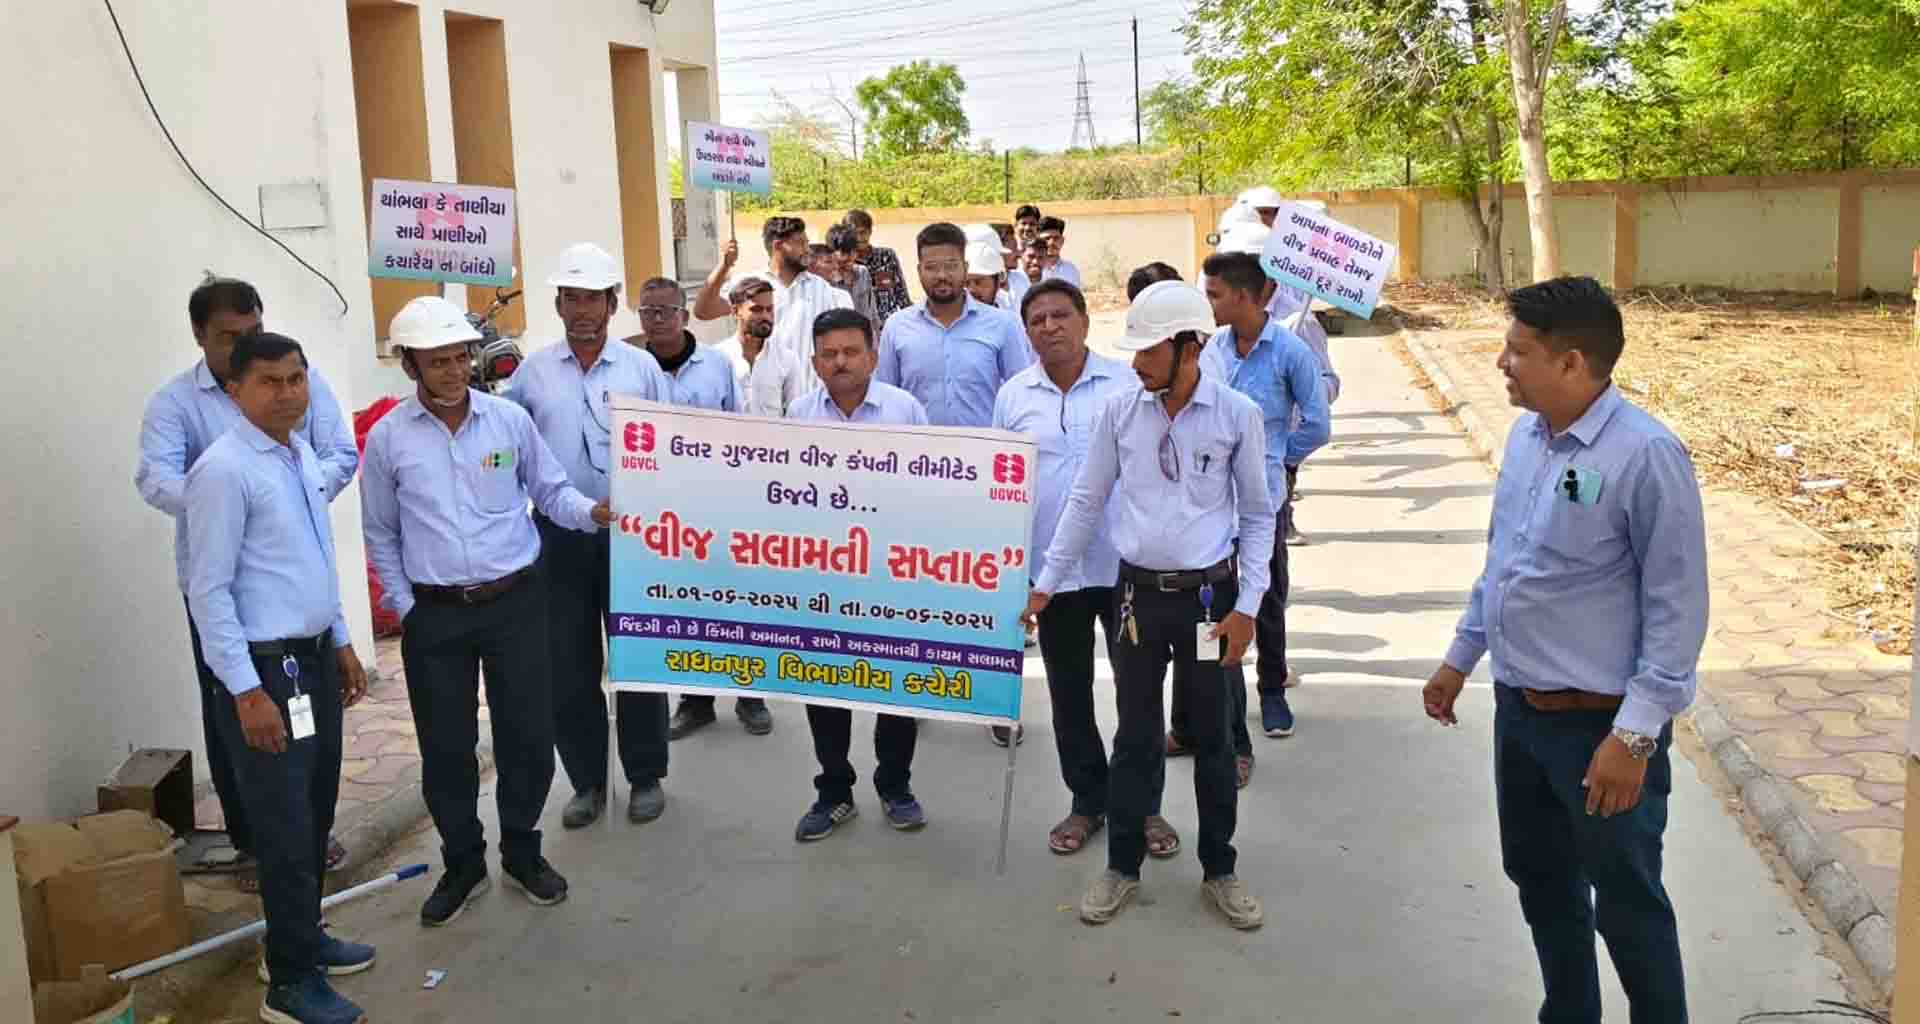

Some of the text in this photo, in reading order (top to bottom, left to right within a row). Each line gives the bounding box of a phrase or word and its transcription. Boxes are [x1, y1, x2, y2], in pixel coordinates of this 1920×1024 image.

[380, 190, 506, 216] થાંભલા કે તાણીયા
[395, 223, 487, 245] સાથે પ્રાણીઓ
[1290, 212, 1384, 261] આપના બાળકોને
[440, 260, 453, 273] ન
[460, 256, 496, 275] બાંધો
[1282, 233, 1374, 281] વીજ પ્રવાહ તેમજ
[1269, 255, 1313, 281] સ્વીચથી
[1316, 276, 1332, 294] દૂર
[621, 456, 660, 471] UGVCL
[670, 434, 978, 481] ઉત્તર ગુજરાત વીજ કંપની લીમીટેડ
[767, 481, 819, 507] ઉજવે
[989, 487, 1029, 503] UGVCL
[729, 525, 869, 576] સલામતી
[808, 592, 830, 613] થી
[619, 616, 660, 634] જિંદગી
[666, 620, 680, 635] તો
[687, 621, 699, 636] છે
[705, 622, 744, 641] કિંમતી
[811, 635, 840, 649] રાખો
[847, 639, 919, 658] અકસ્માતથી
[925, 648, 961, 663] કાયમ
[665, 649, 973, 700] રાધનપુર વિભાગીય કચેરી
